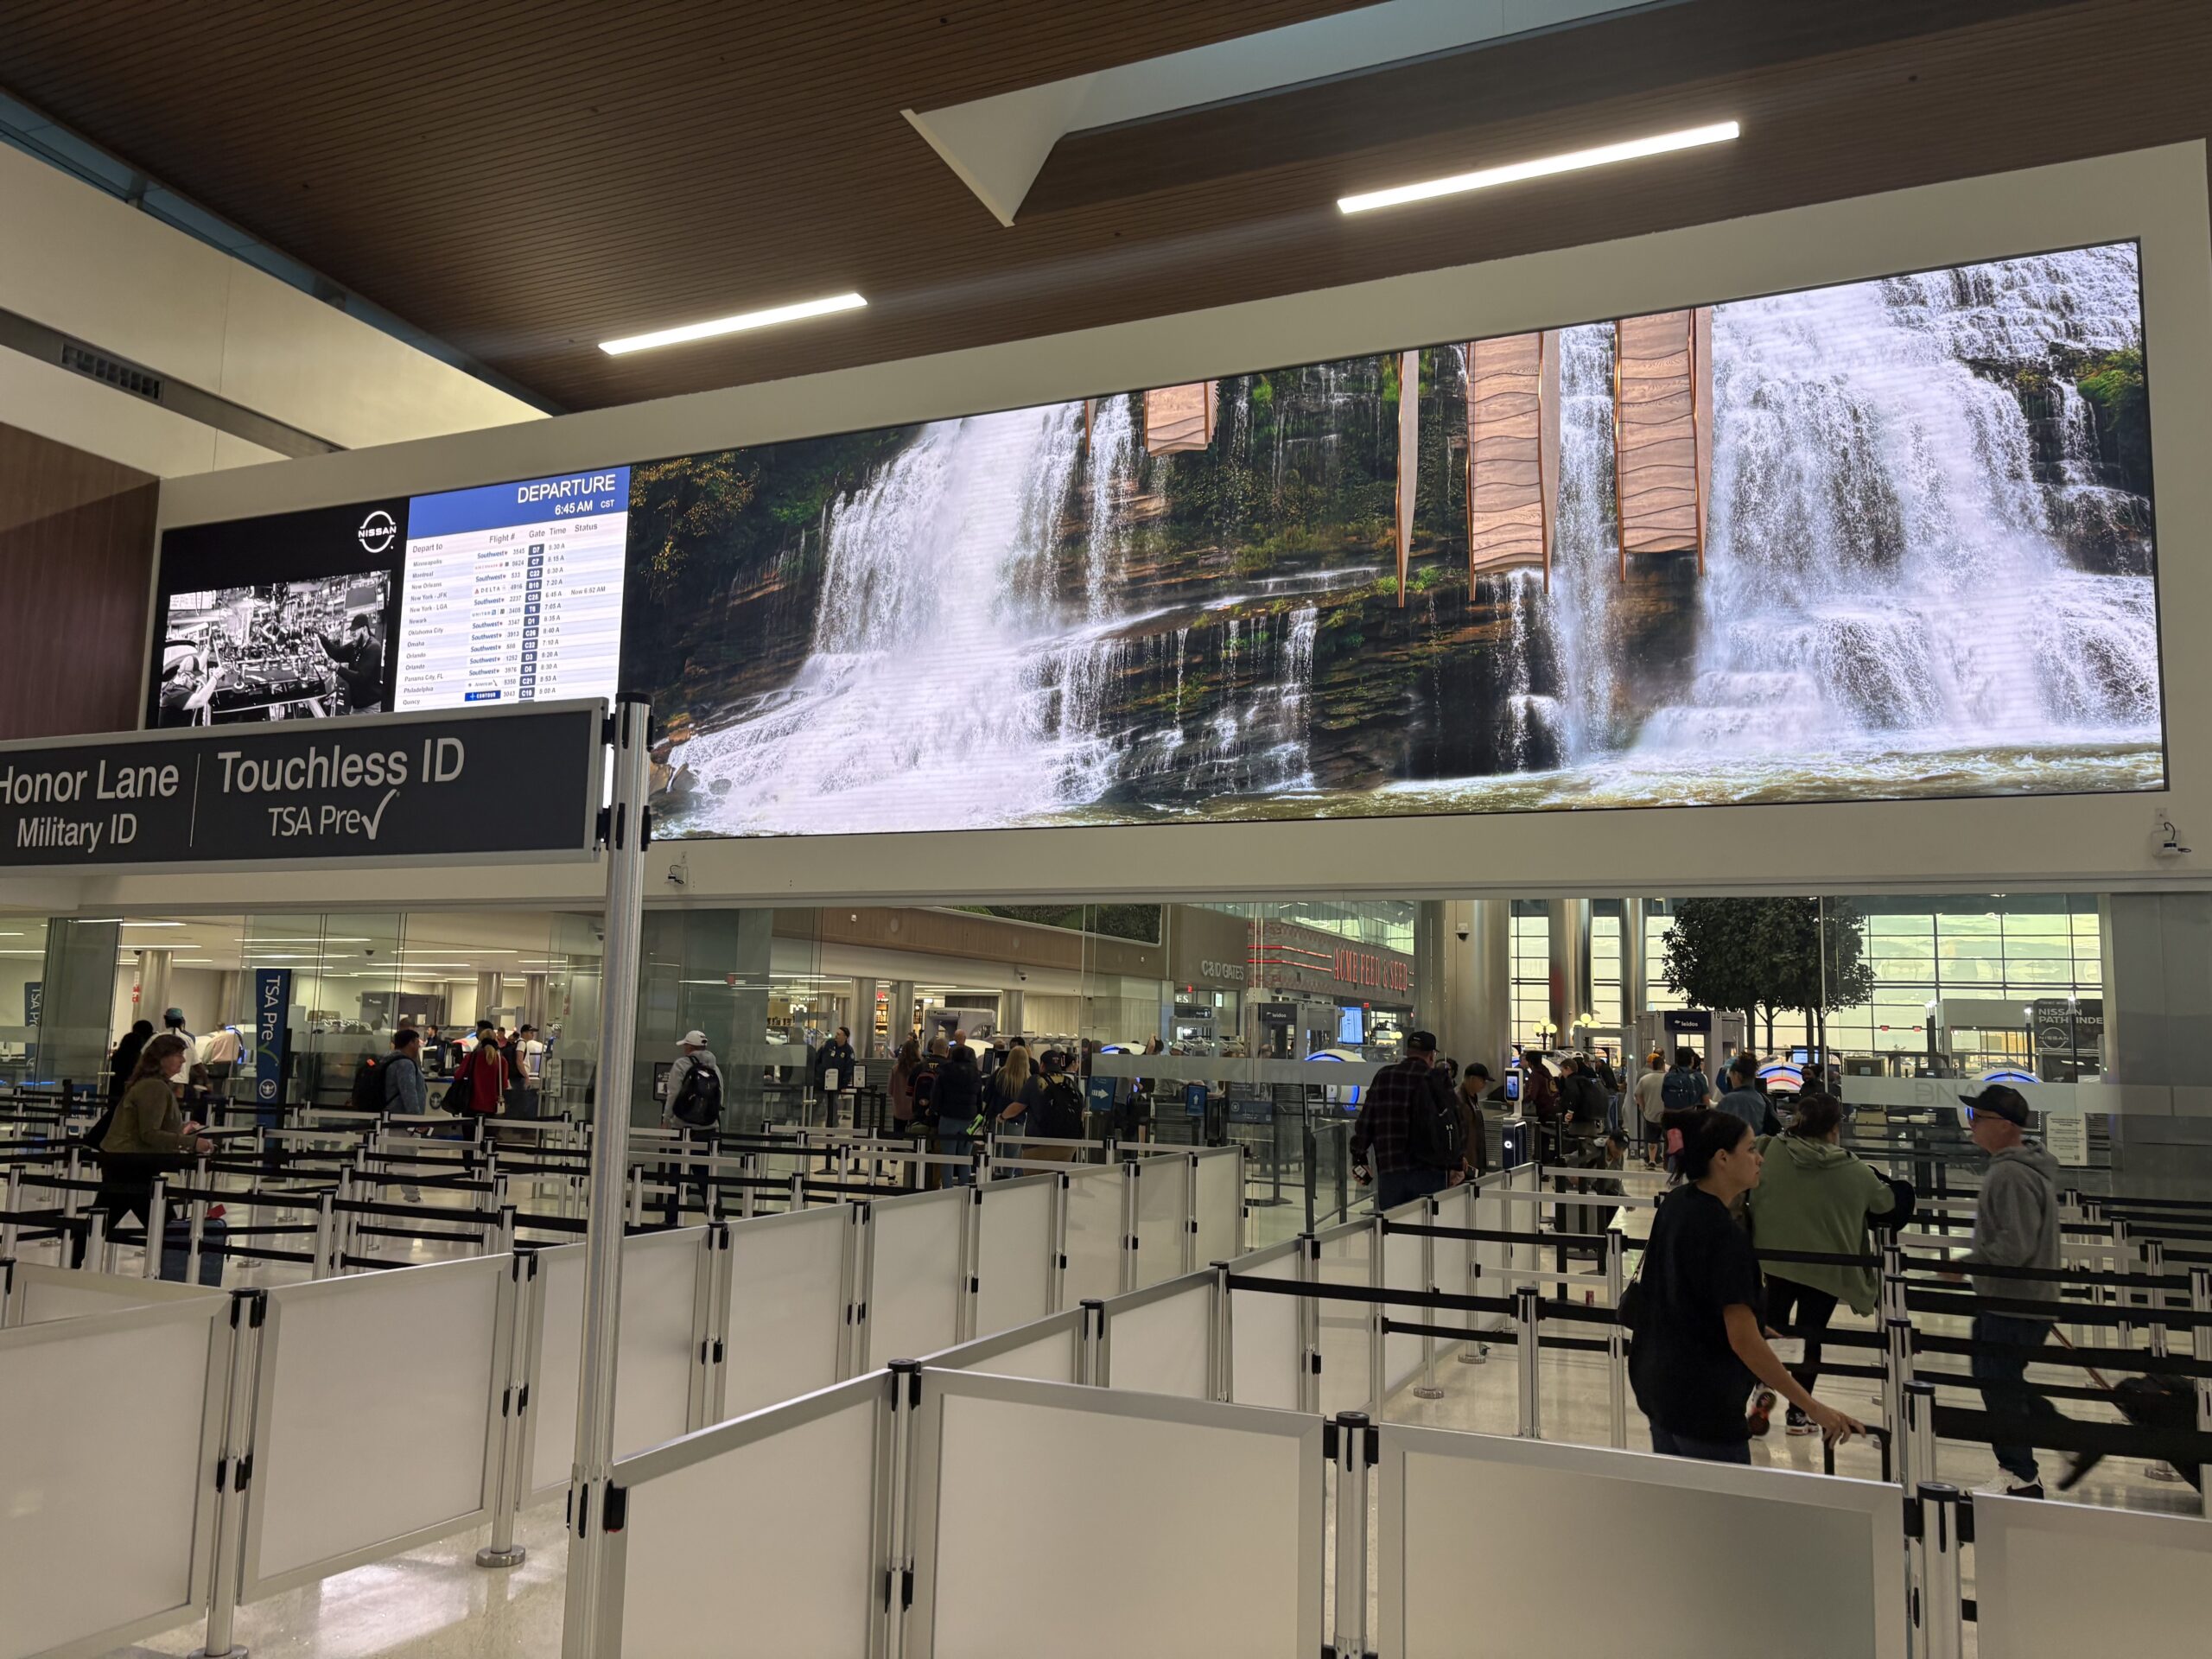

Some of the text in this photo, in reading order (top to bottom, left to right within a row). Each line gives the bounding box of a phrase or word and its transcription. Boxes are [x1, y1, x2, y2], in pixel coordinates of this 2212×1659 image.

[518, 474, 616, 503] DEPARTURE
[555, 499, 615, 516] 6:45 AM CST
[358, 525, 397, 537] NISSAN
[412, 543, 434, 553] Depart
[489, 533, 510, 543] Flight
[529, 529, 545, 538] Gate
[549, 526, 566, 536] Time
[574, 522, 598, 532] Status
[412, 558, 442, 568] Minneapolis
[476, 550, 504, 558] Southwest
[531, 545, 539, 554] D7
[531, 557, 538, 566] C7
[472, 620, 499, 629] Southwest
[218, 737, 465, 793] Touchless ID
[0, 760, 179, 804] Honor Lane
[268, 805, 360, 836] TSA Pre
[17, 813, 137, 854] Military ID
[1222, 963, 1244, 981] GATES
[1333, 947, 1408, 991] ACME FEED & SEED
[30, 987, 41, 1009] TSA
[262, 976, 281, 1040] TSA Pre
[1713, 1010, 1720, 1019] 10
[2038, 1015, 2103, 1025] PATHINDE
